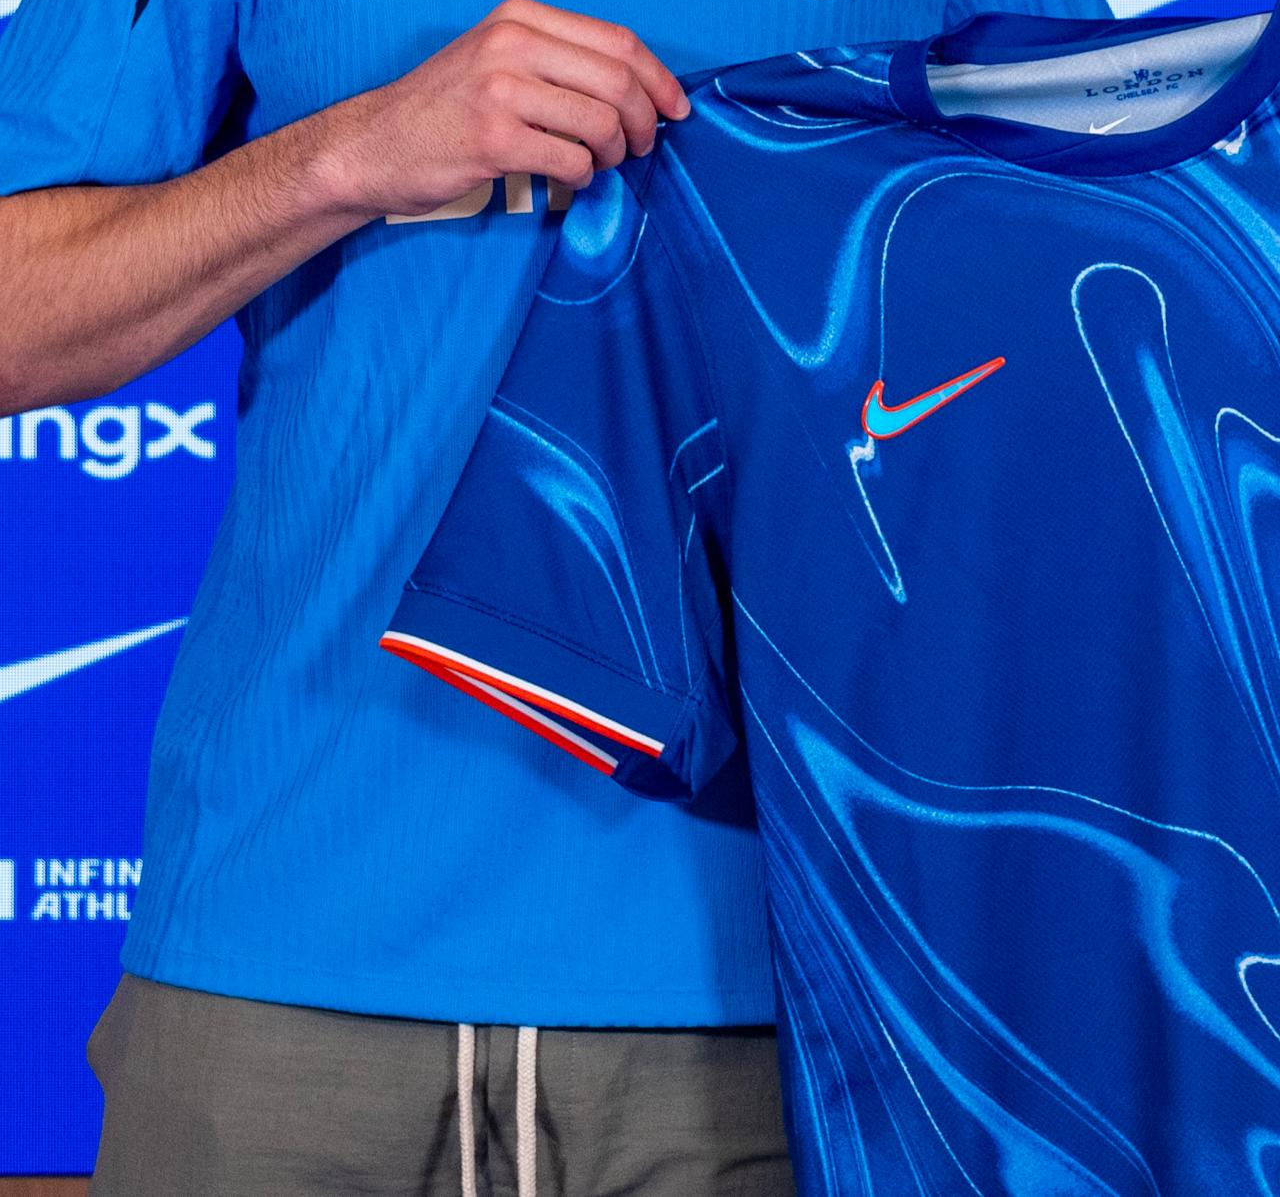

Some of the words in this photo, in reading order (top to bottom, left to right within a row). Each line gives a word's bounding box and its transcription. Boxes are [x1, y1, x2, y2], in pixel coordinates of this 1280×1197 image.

[1085, 68, 1204, 97] LONDON
[1116, 87, 1160, 101] CHELSEA
[38, 860, 144, 886] INFIN
[35, 894, 131, 921] ATHL
